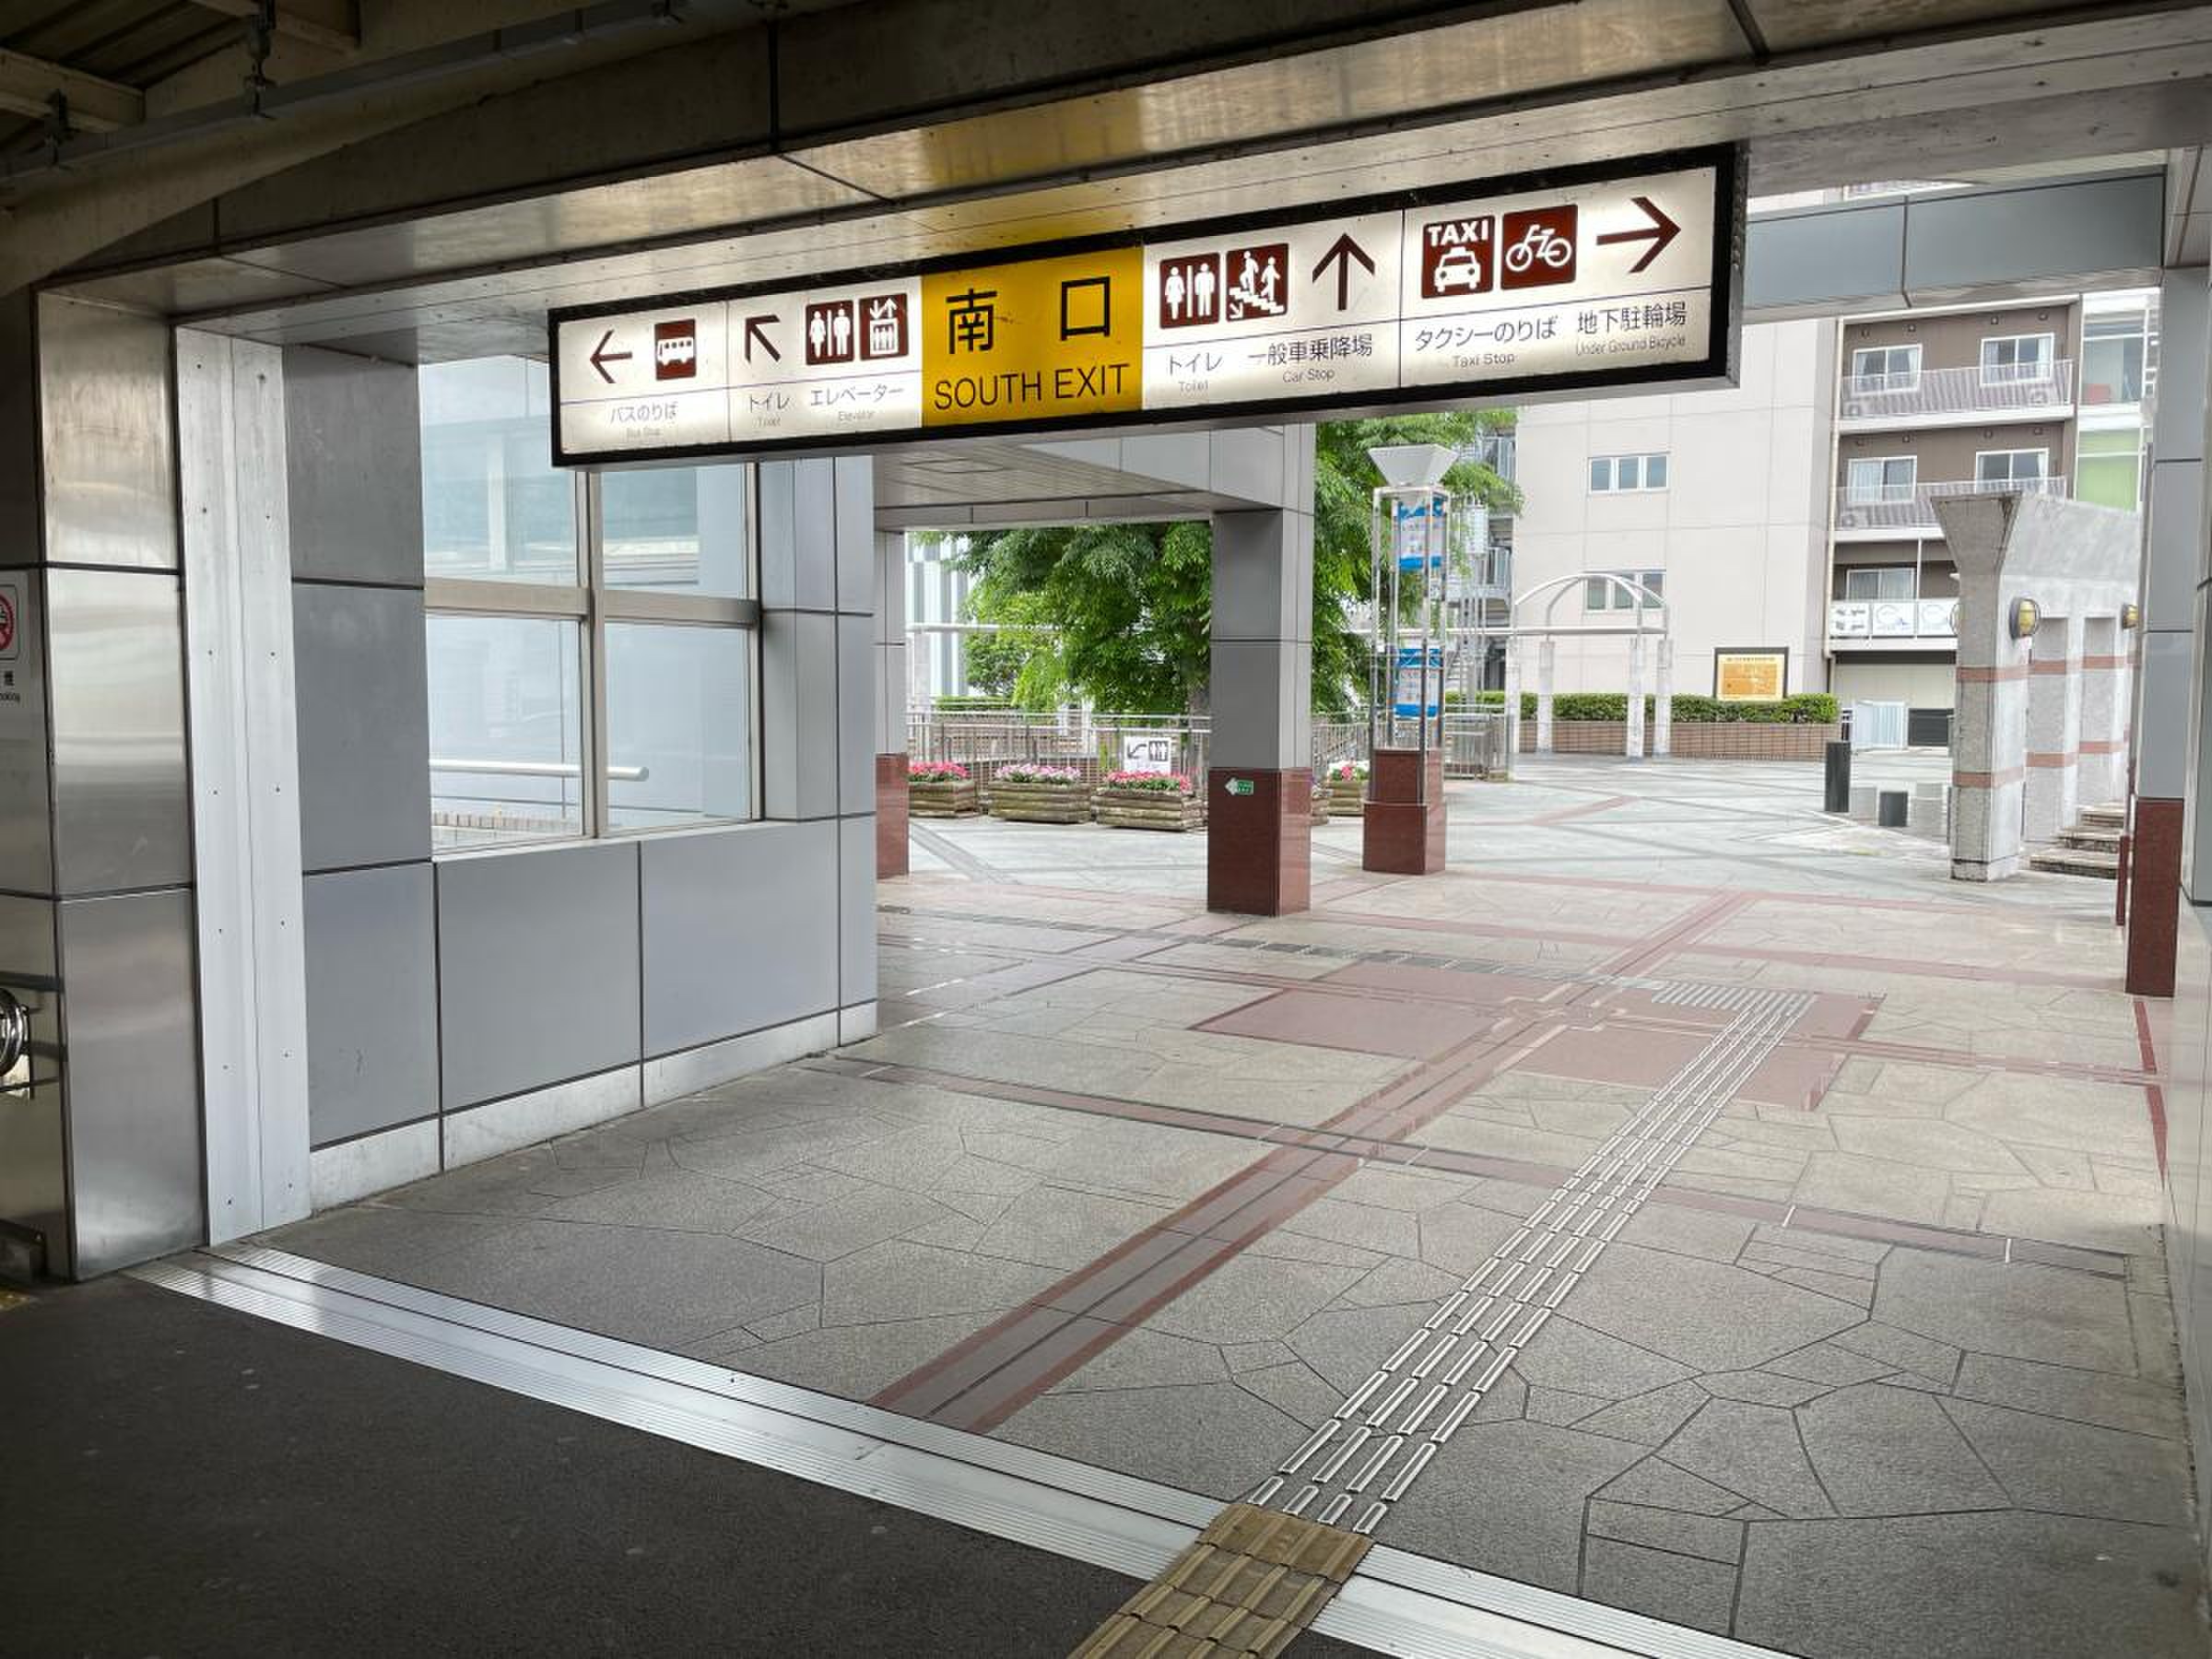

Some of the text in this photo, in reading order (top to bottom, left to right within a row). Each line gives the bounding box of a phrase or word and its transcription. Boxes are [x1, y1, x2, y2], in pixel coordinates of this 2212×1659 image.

[1429, 220, 1489, 247] TAXI
[1415, 300, 1688, 351] タクシーのりば 地下駐輪場
[1168, 334, 1372, 375] トイレ 一般車乗降場
[1453, 352, 1515, 368] Taxi Stop
[935, 363, 1130, 410] SOUTH EXIT
[1179, 380, 1209, 394] Toilet
[1282, 369, 1335, 384] Car Stop
[749, 382, 905, 414] トイレ エレベーター
[610, 401, 678, 425] バスのりば
